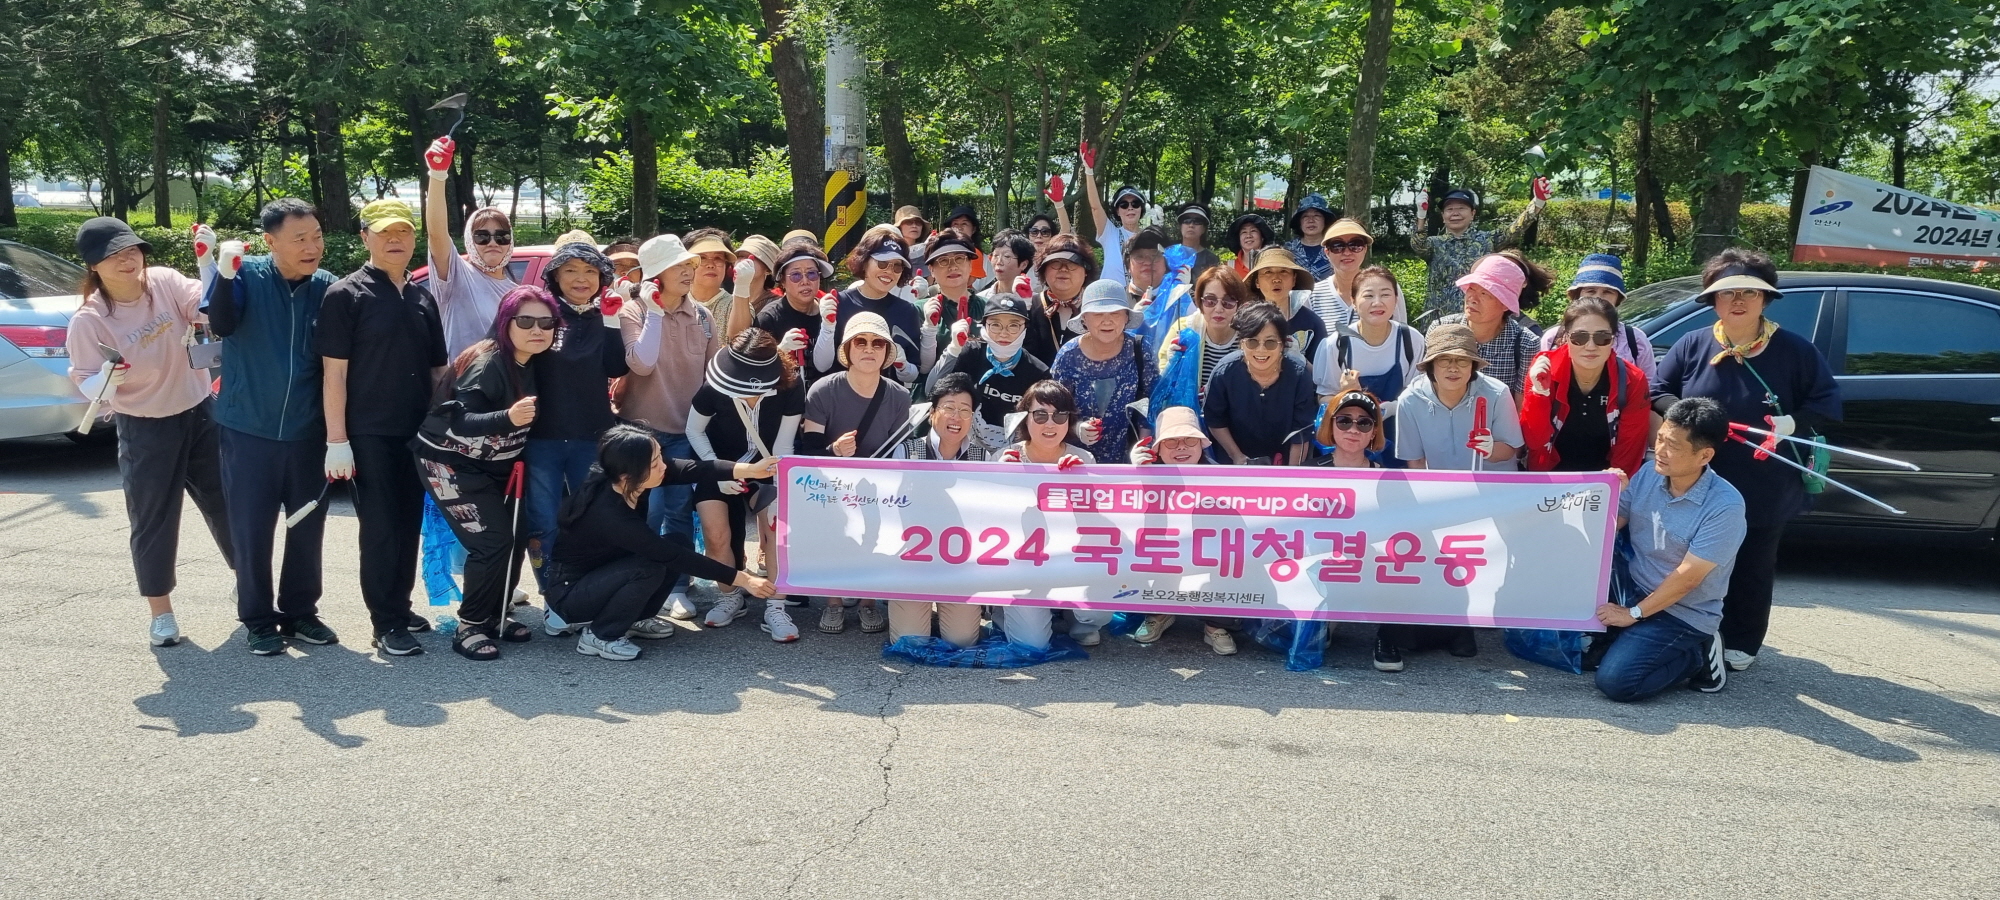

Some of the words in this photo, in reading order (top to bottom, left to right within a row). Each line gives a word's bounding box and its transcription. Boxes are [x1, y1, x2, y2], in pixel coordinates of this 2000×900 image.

[1814, 219, 1841, 228] 안산시
[1913, 225, 1993, 247] 2024년
[796, 474, 829, 492] 시민과
[882, 495, 912, 508] 안산
[1047, 488, 1114, 510] 클린업
[1292, 492, 1347, 517] day)
[899, 525, 1050, 567] 2024
[1072, 525, 1488, 588] 국토대청결운동
[1141, 589, 1265, 604] 본오2동행정복지센터
